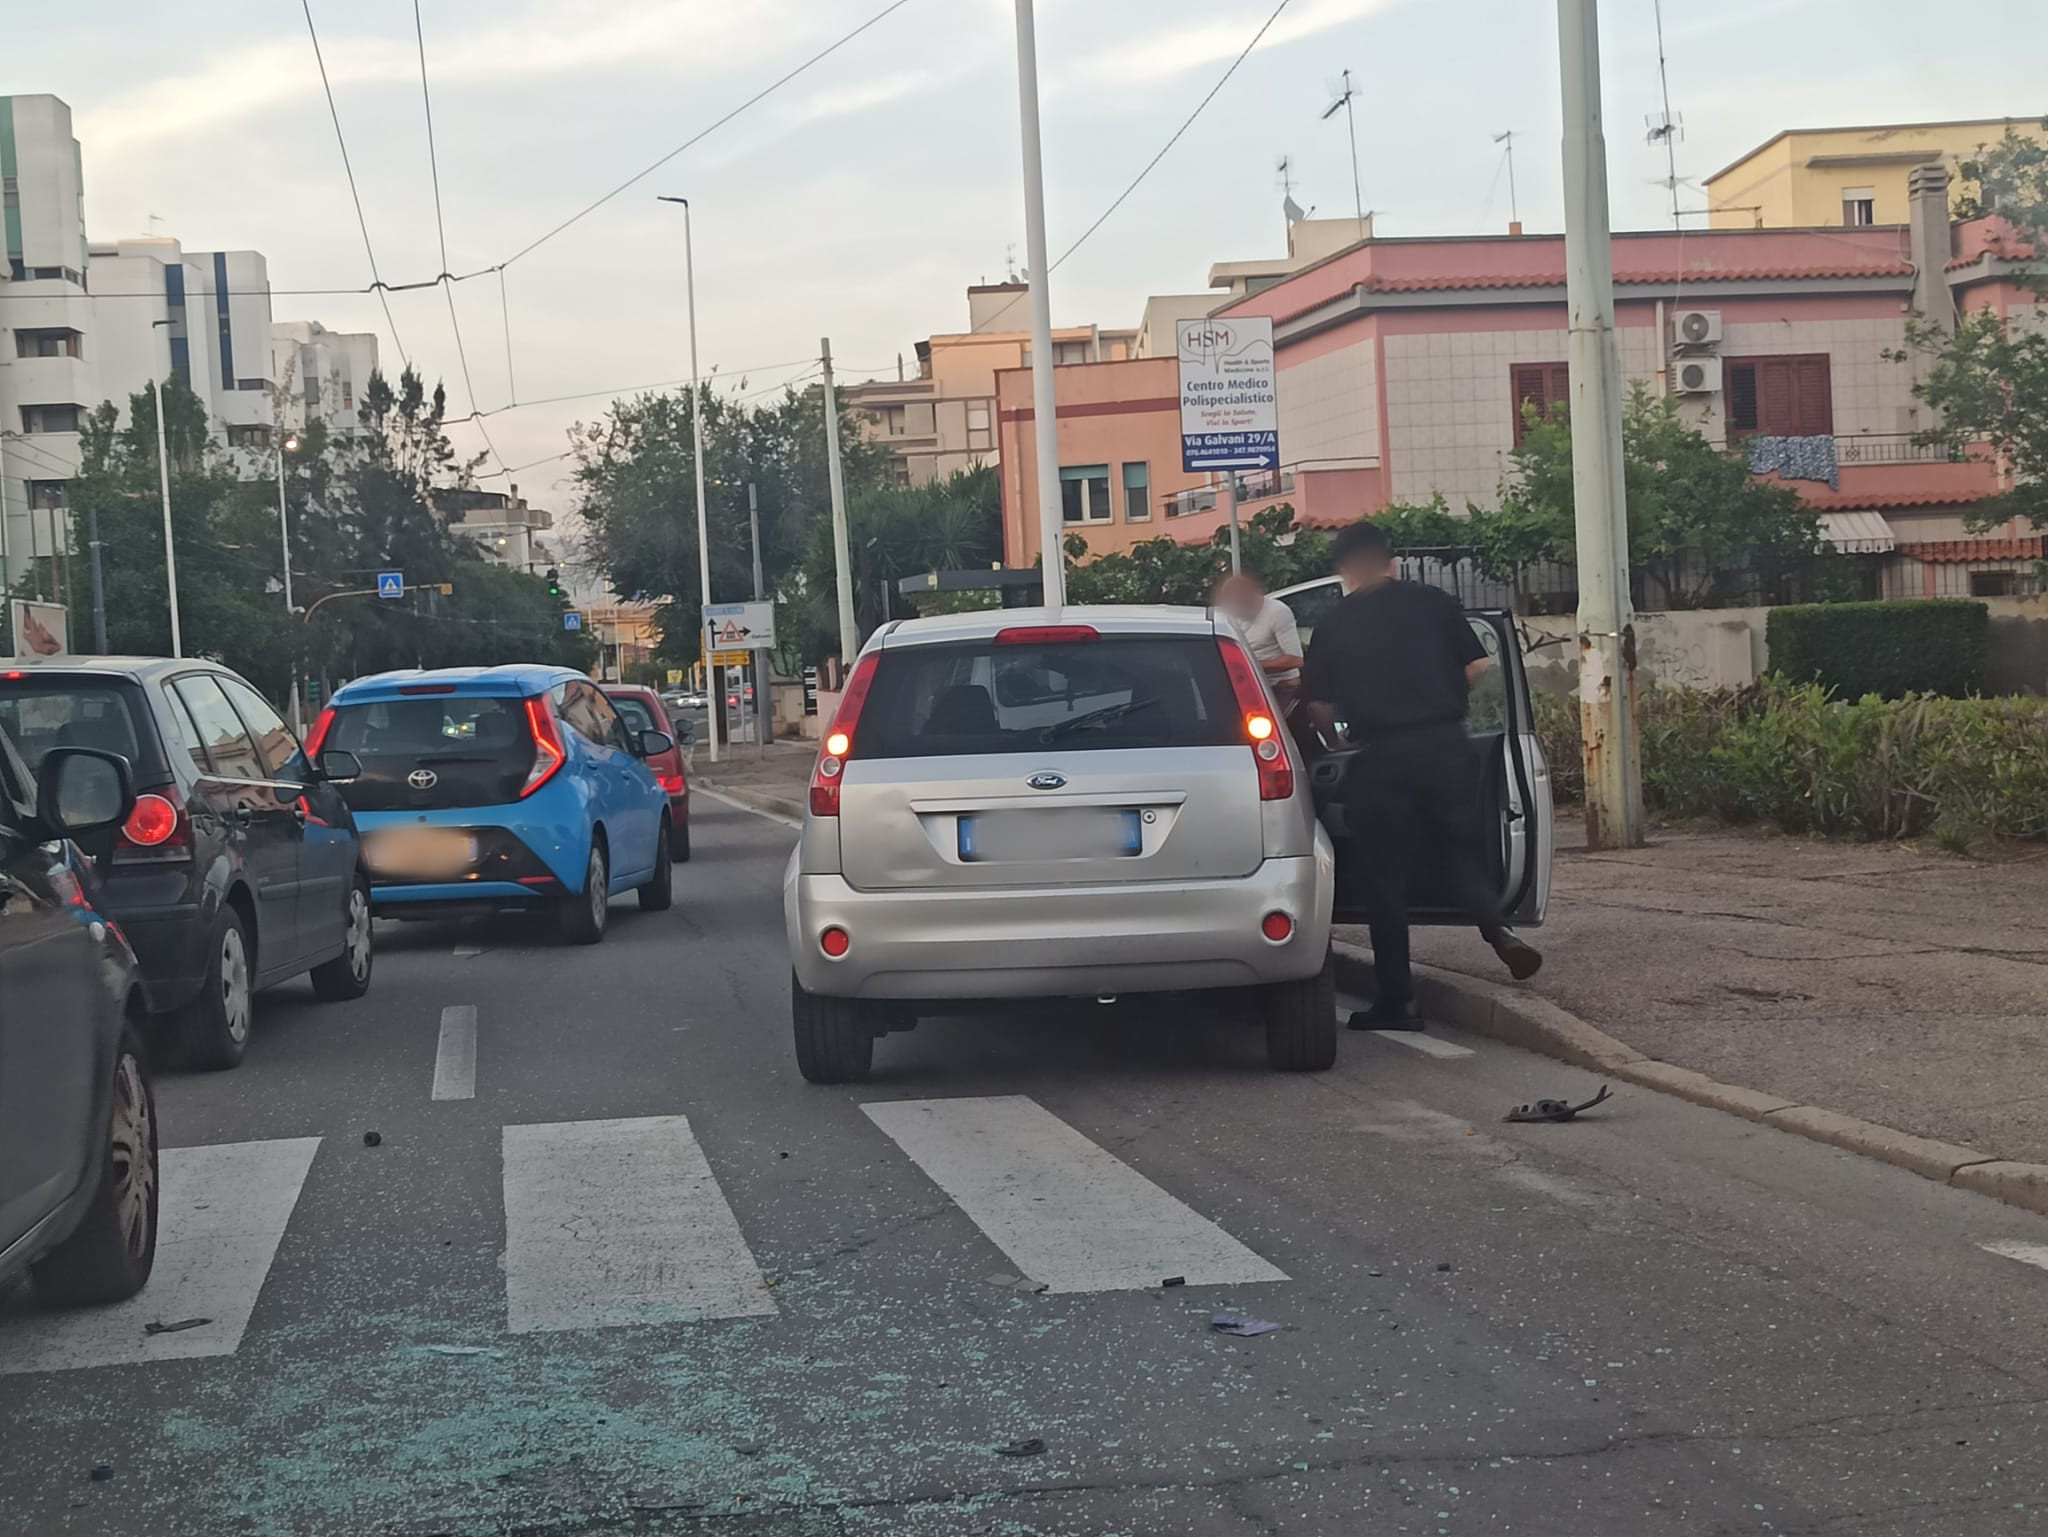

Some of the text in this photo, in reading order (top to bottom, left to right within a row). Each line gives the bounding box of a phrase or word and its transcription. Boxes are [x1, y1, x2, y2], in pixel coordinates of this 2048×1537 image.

[1187, 331, 1229, 347] HSM
[1187, 378, 1268, 391] Centro Medico
[1183, 393, 1274, 407] Polispecialistico
[1185, 432, 1275, 446] Via Galvani 29/A
[1032, 775, 1058, 785] Ford
